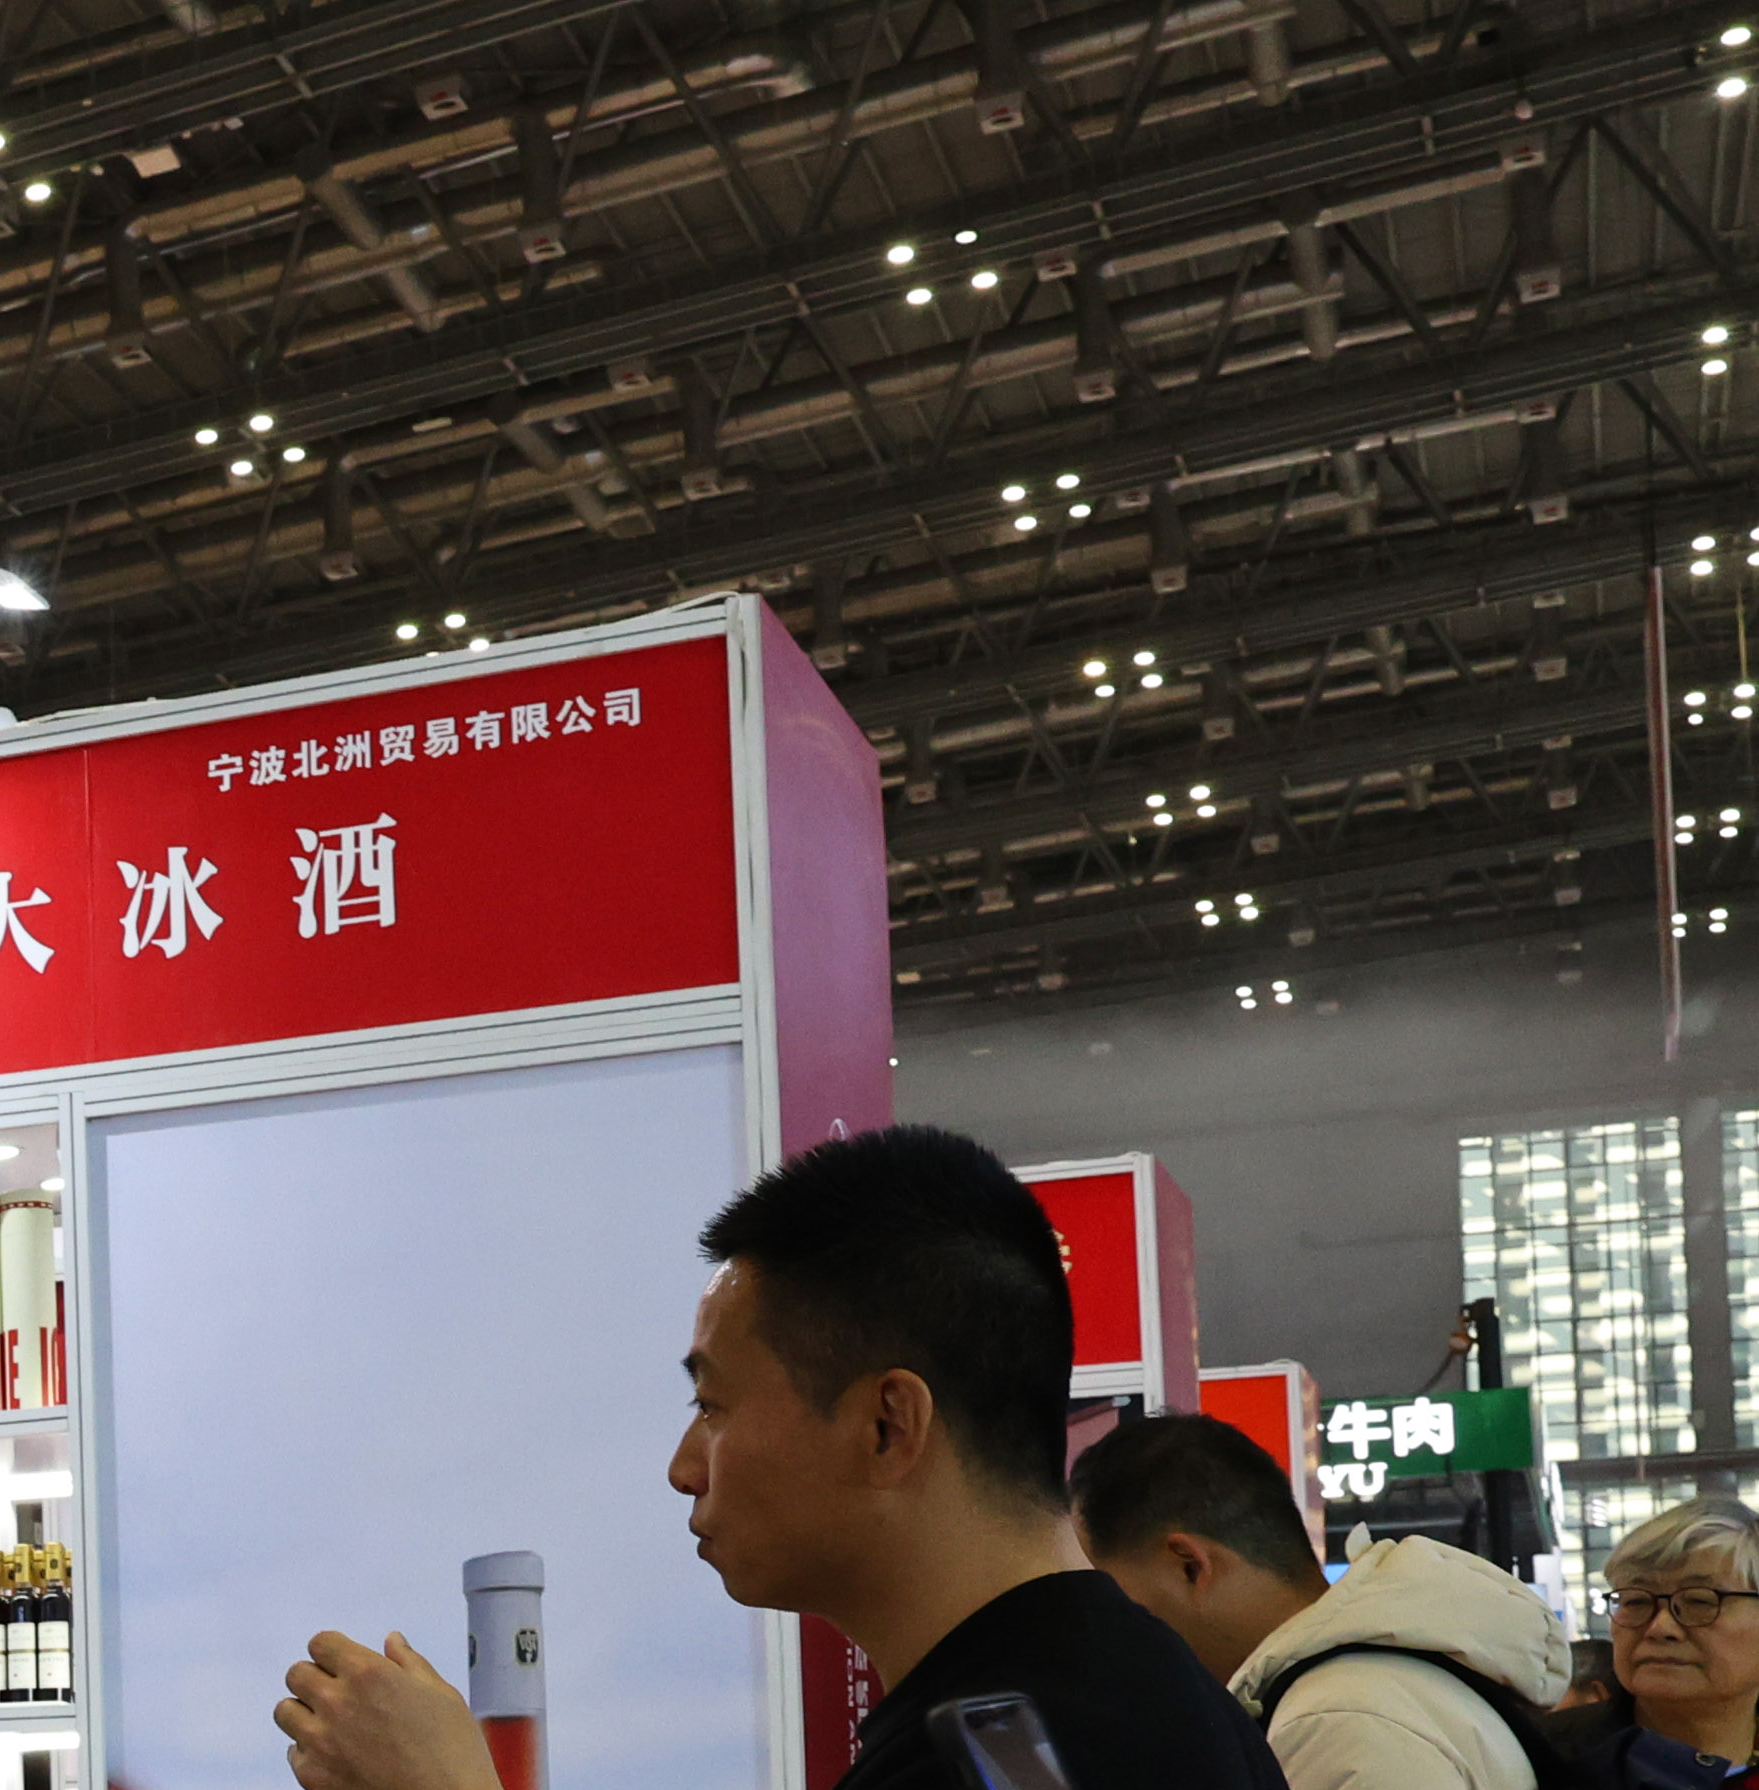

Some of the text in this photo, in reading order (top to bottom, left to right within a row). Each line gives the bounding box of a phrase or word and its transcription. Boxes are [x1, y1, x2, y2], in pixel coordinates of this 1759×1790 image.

[206, 686, 643, 793] 宁波北洲贸易有限公司
[1327, 1397, 1455, 1460] 牛肉
